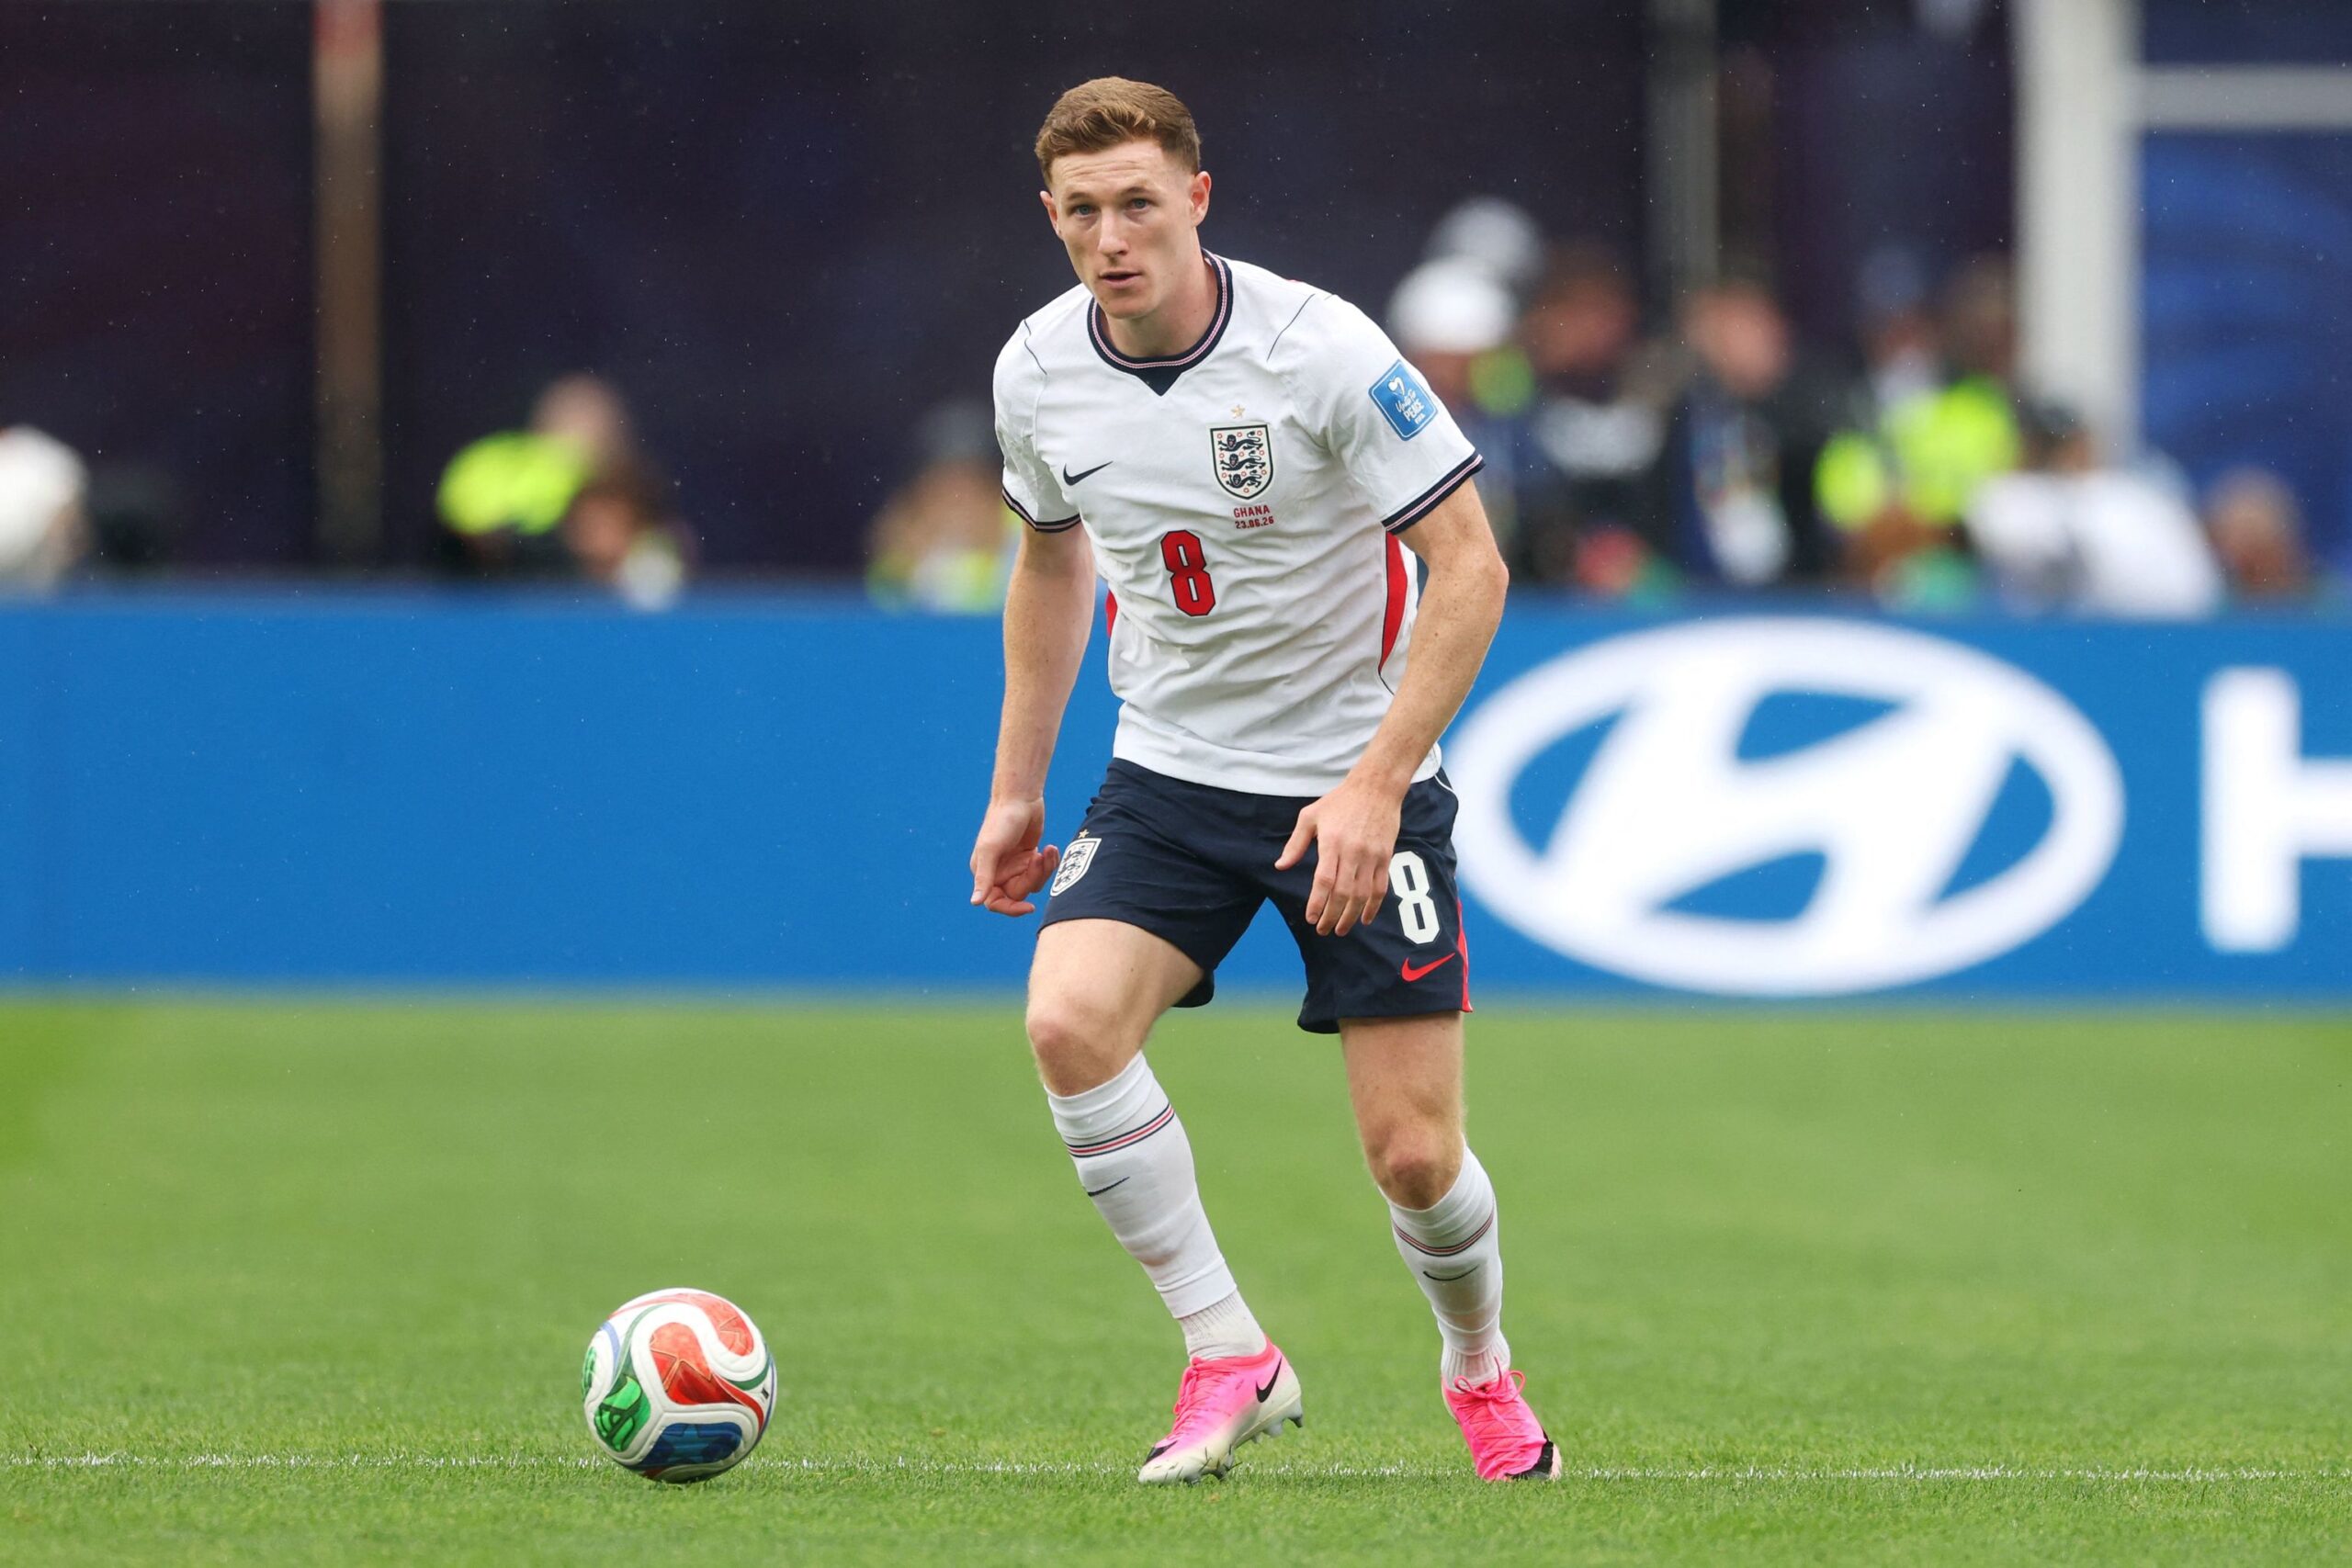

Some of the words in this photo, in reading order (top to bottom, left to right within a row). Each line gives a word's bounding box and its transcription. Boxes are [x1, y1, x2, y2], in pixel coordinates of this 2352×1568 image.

[1234, 504, 1271, 518] GHANA
[1235, 515, 1274, 529] 23.06.26
[1160, 529, 1216, 616] 8
[1388, 851, 1440, 944] 8
